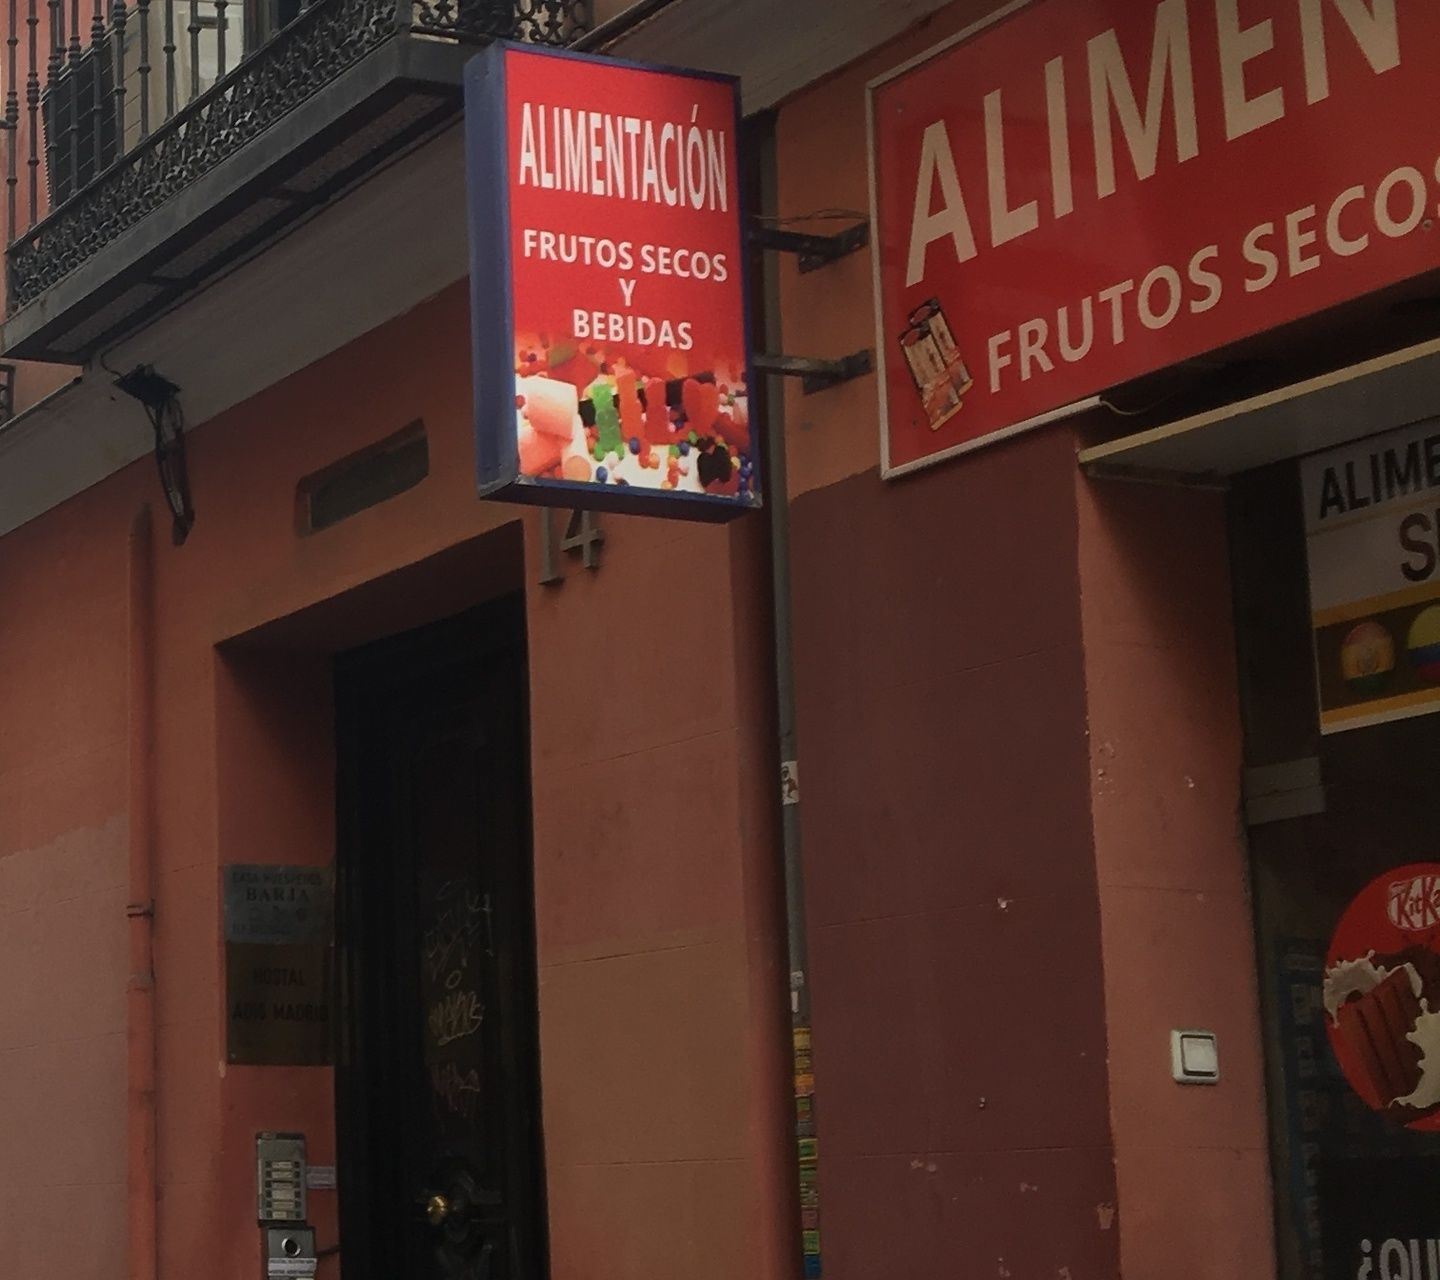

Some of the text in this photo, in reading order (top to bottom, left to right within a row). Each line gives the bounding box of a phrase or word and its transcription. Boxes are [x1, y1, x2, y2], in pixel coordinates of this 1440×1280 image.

[519, 102, 729, 213] ALIMENTACIÓN
[524, 229, 729, 283] FRUTOS SECOS
[988, 154, 1440, 395] FRUTOS SECO
[619, 278, 637, 308] Y
[573, 308, 694, 351] BEBIDAS
[1399, 508, 1440, 582] S
